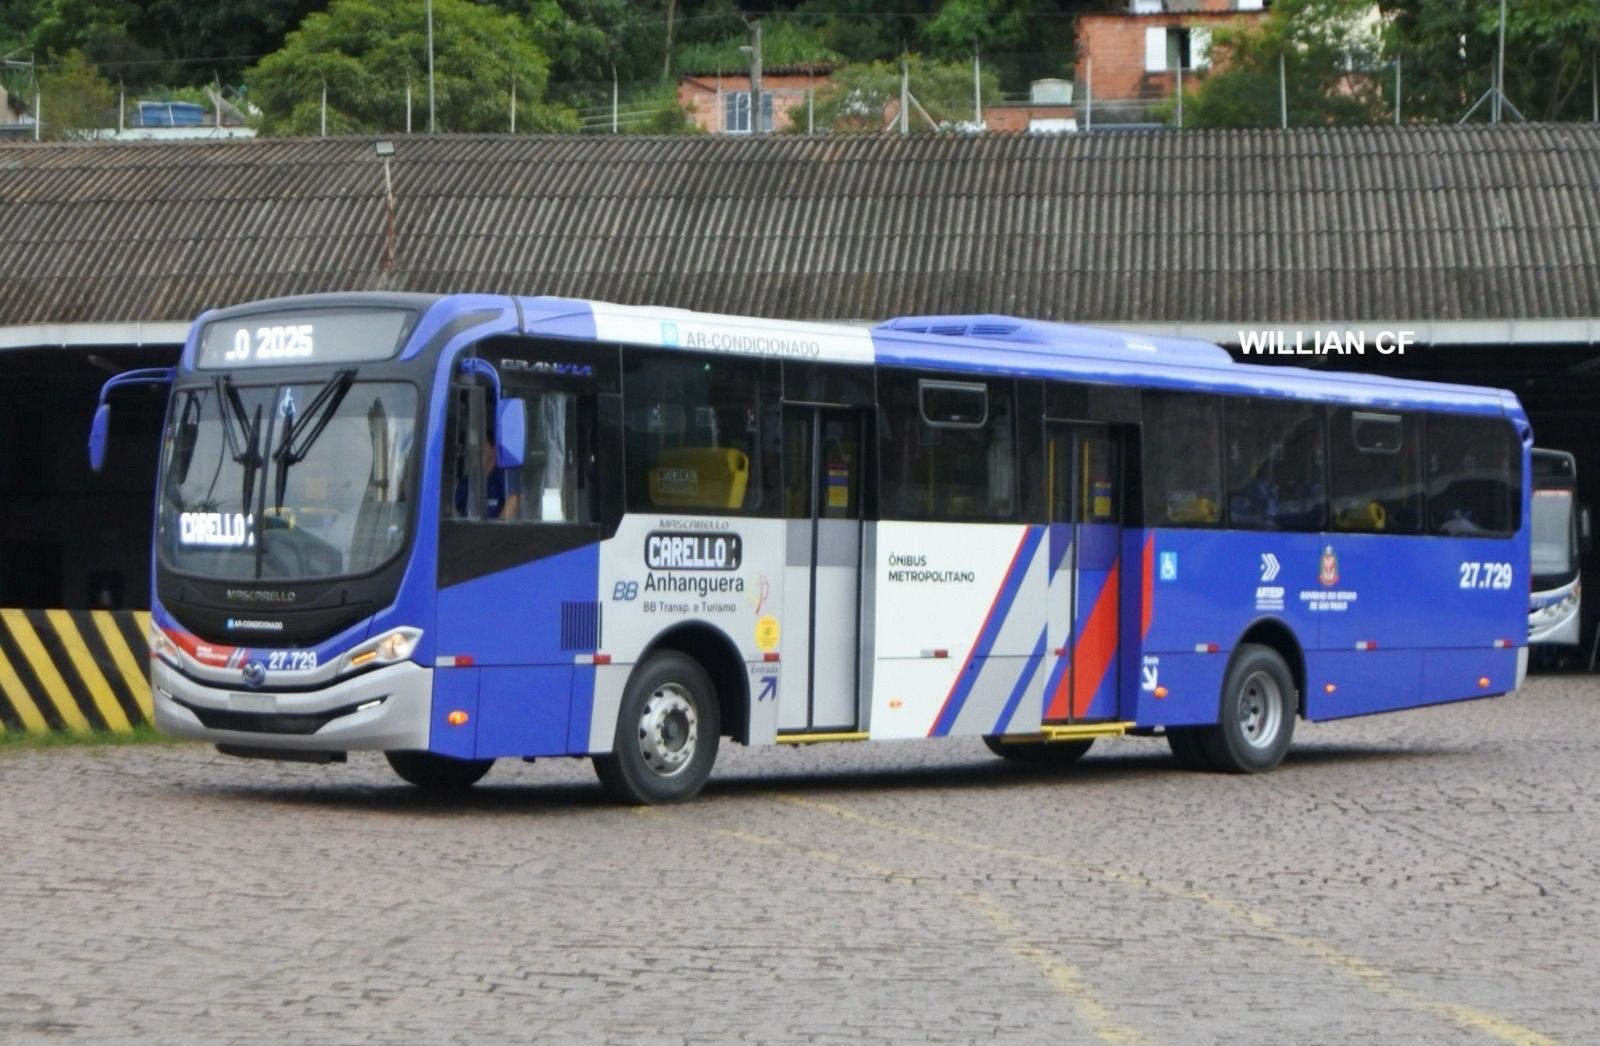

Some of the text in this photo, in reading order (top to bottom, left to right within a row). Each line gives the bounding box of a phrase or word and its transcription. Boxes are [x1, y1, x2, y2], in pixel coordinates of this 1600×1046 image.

[225, 324, 314, 361] O 2025
[686, 331, 821, 357] AR-CONDICIONADO
[179, 512, 246, 546] CARELLO
[659, 518, 730, 530] MASCARELLO
[648, 536, 727, 568] CARELLO
[888, 551, 927, 566] ÔNIBUS
[644, 571, 745, 597] Anhanguera
[888, 570, 975, 582] METROPOLITANO
[1459, 561, 1513, 589] 27.729
[612, 581, 639, 601] BB
[643, 601, 657, 612] BB
[693, 604, 700, 613] e
[702, 601, 737, 612] Turismo
[268, 651, 318, 670] 27.729
